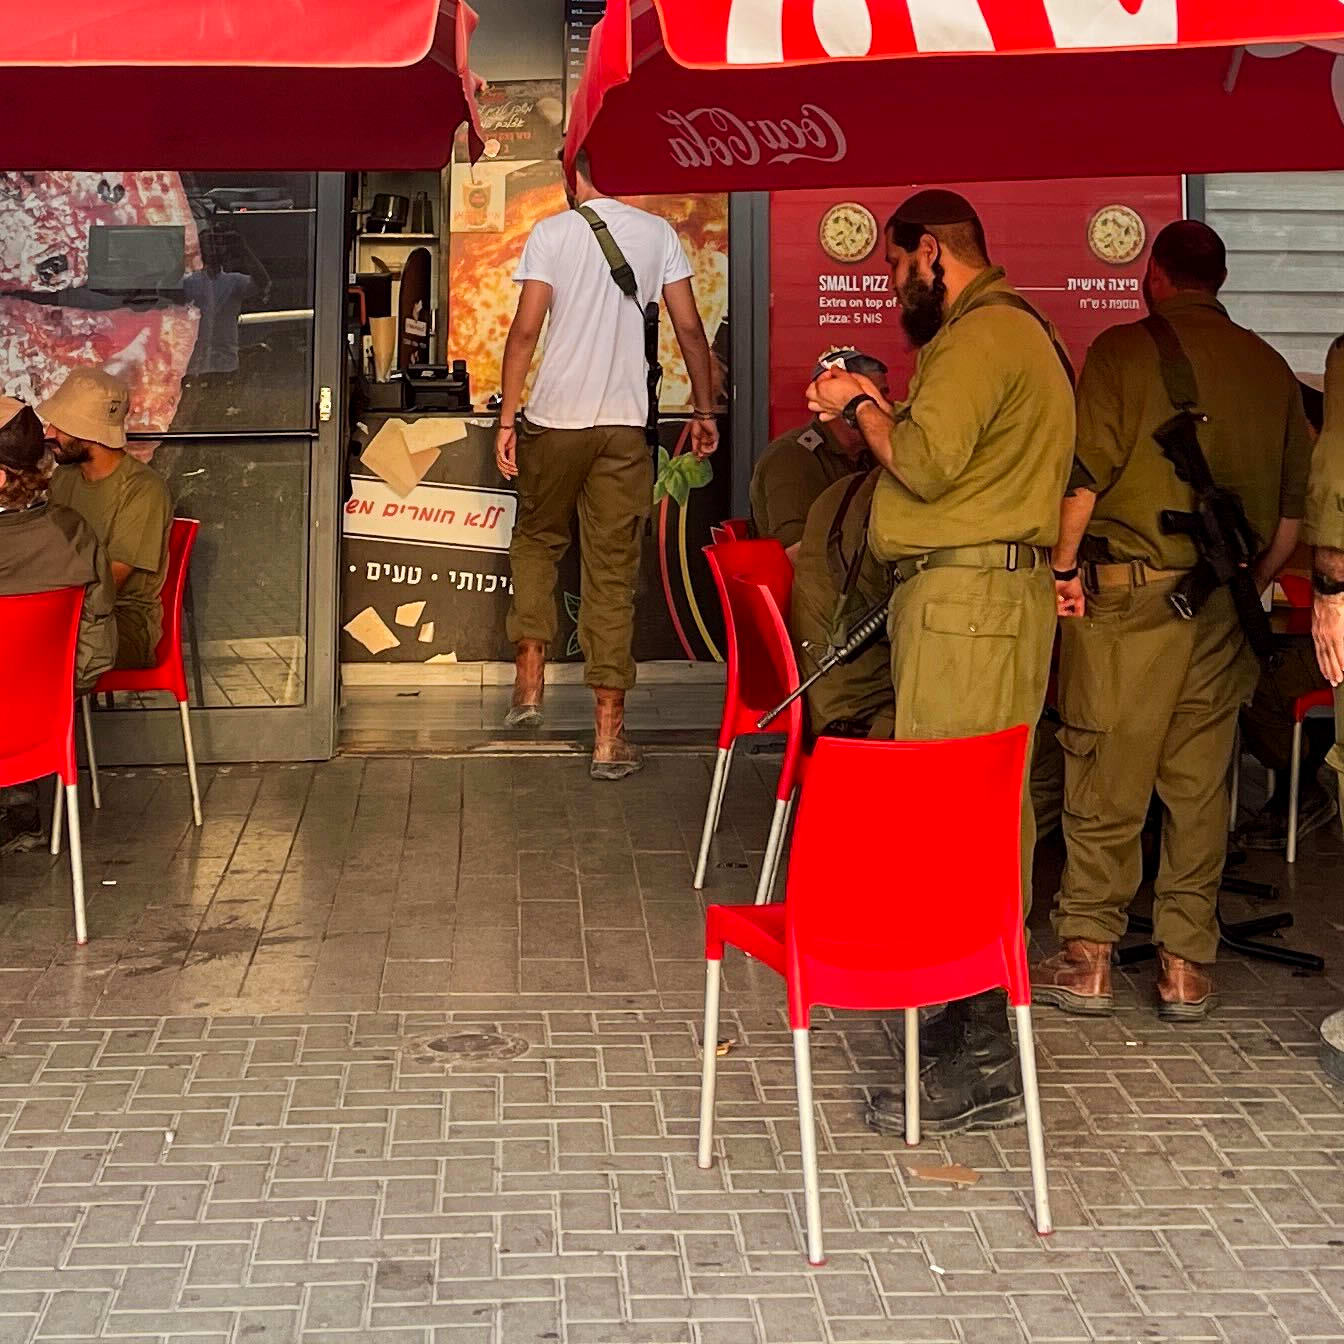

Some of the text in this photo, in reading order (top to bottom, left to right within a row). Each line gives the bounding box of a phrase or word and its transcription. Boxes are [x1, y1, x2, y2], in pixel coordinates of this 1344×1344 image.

[819, 275, 889, 291] SMALL PIZZ
[1067, 278, 1139, 291] פיצה אישית
[819, 296, 897, 310] Extra on top of
[1080, 298, 1140, 309] תוספת 5 ש"ח
[819, 313, 882, 326] pizza: 5 NIS
[383, 503, 455, 524] חומרים
[464, 506, 505, 529] ללא
[367, 562, 422, 584] טעים
